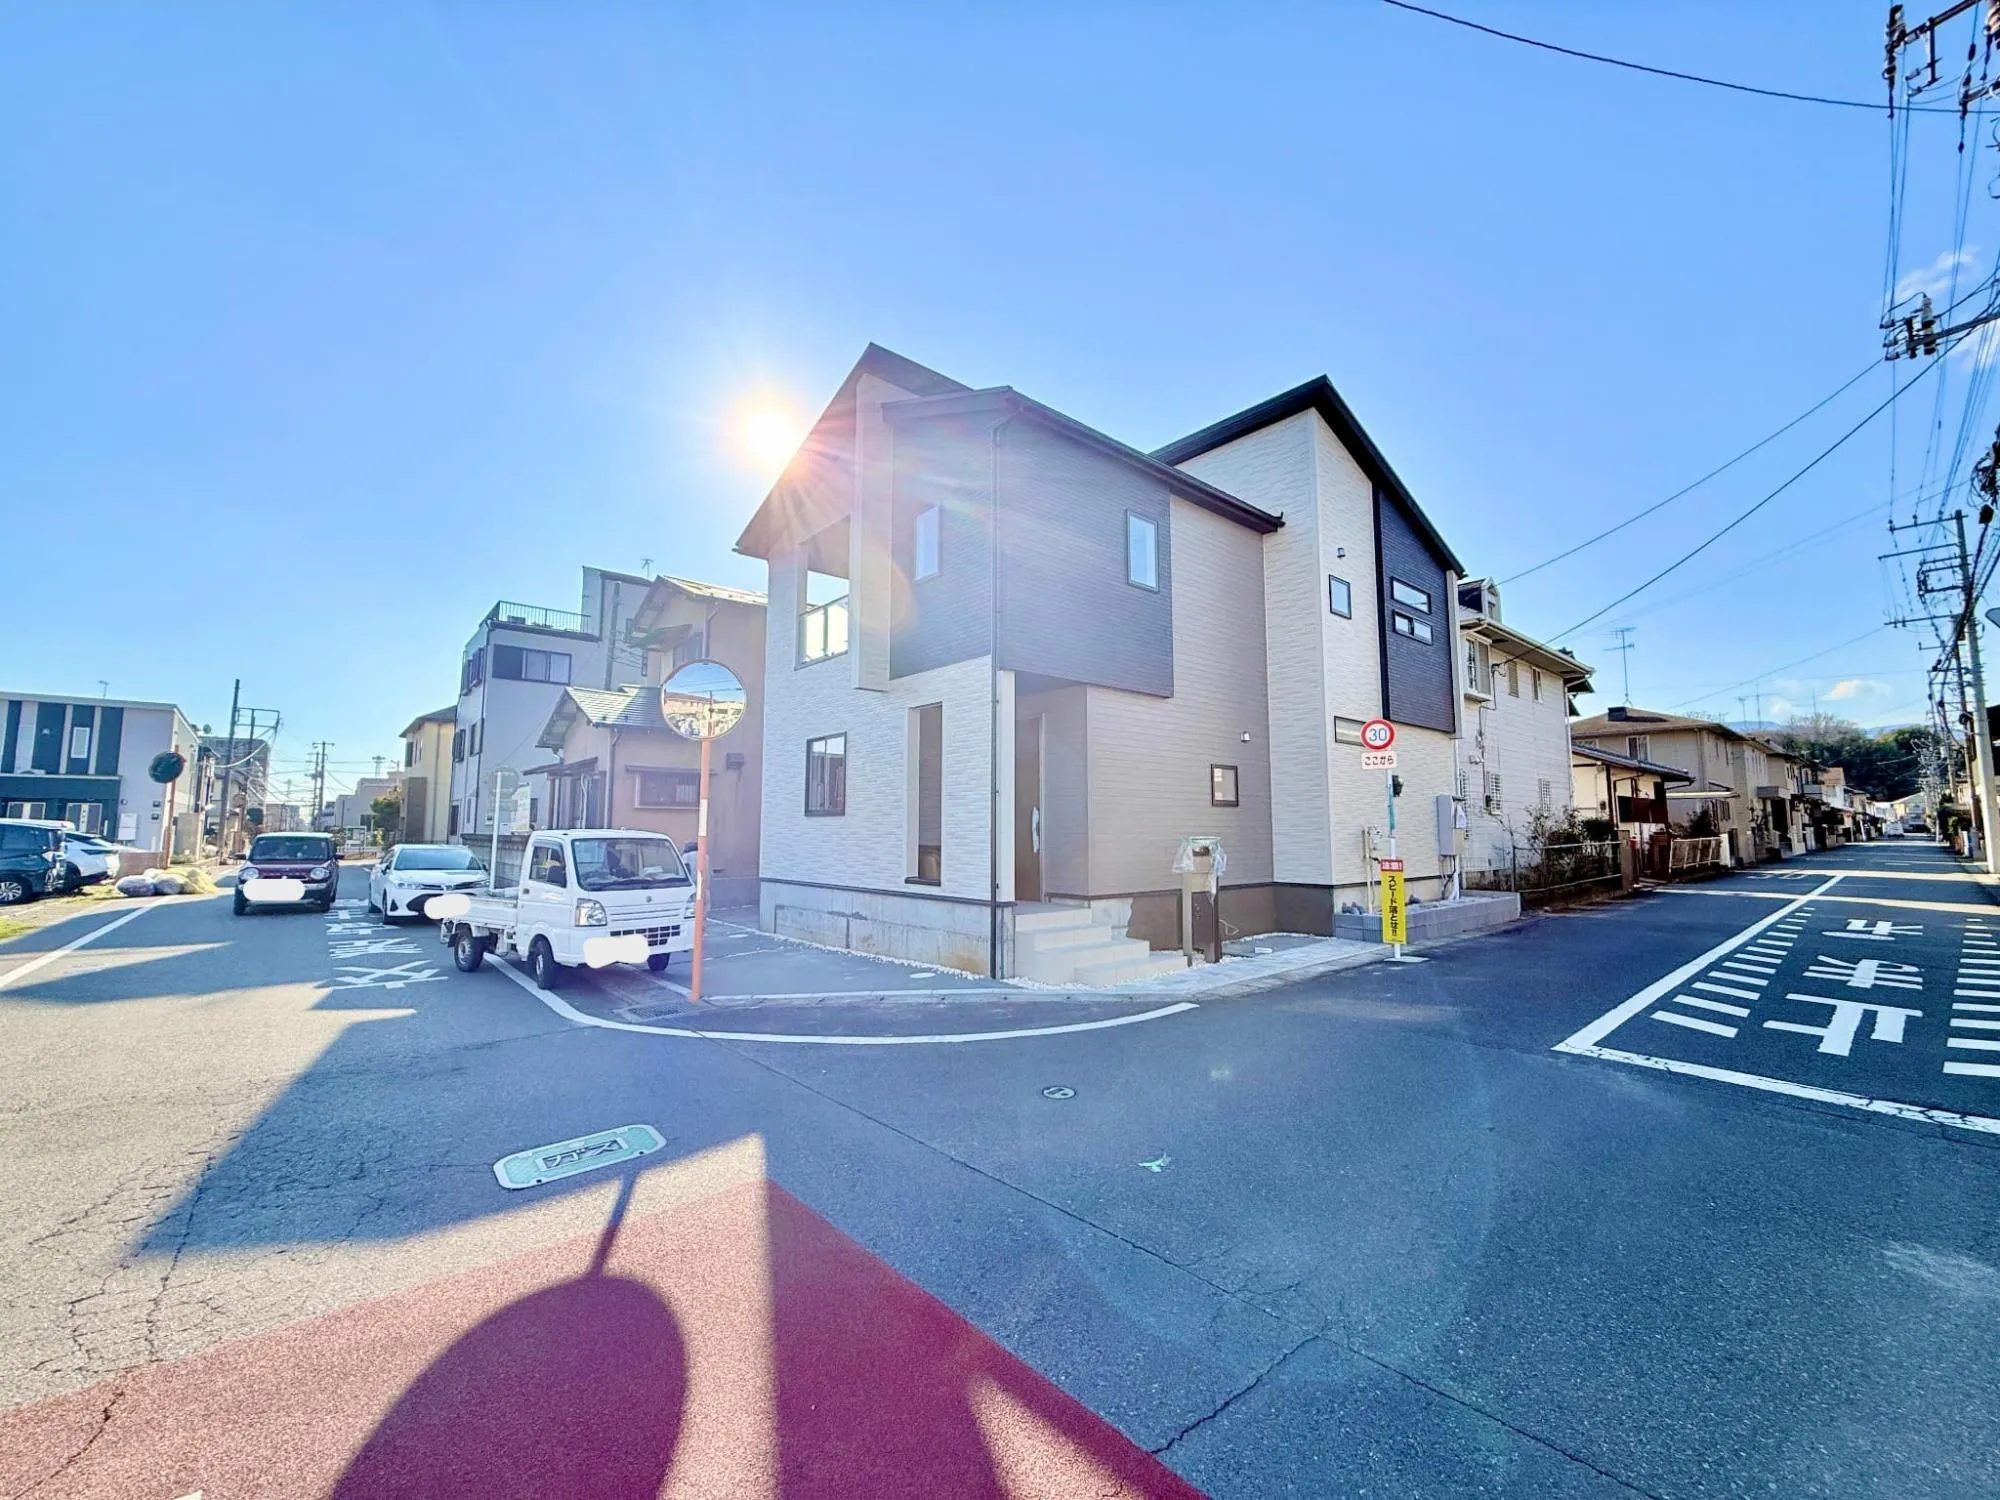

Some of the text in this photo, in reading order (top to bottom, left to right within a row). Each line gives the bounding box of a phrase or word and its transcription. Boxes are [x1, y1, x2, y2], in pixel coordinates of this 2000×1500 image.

[1368, 727, 1388, 743] 30
[1364, 754, 1395, 766] ここから
[1762, 918, 1924, 1057] 止まれ
[545, 1143, 616, 1167] ガス
